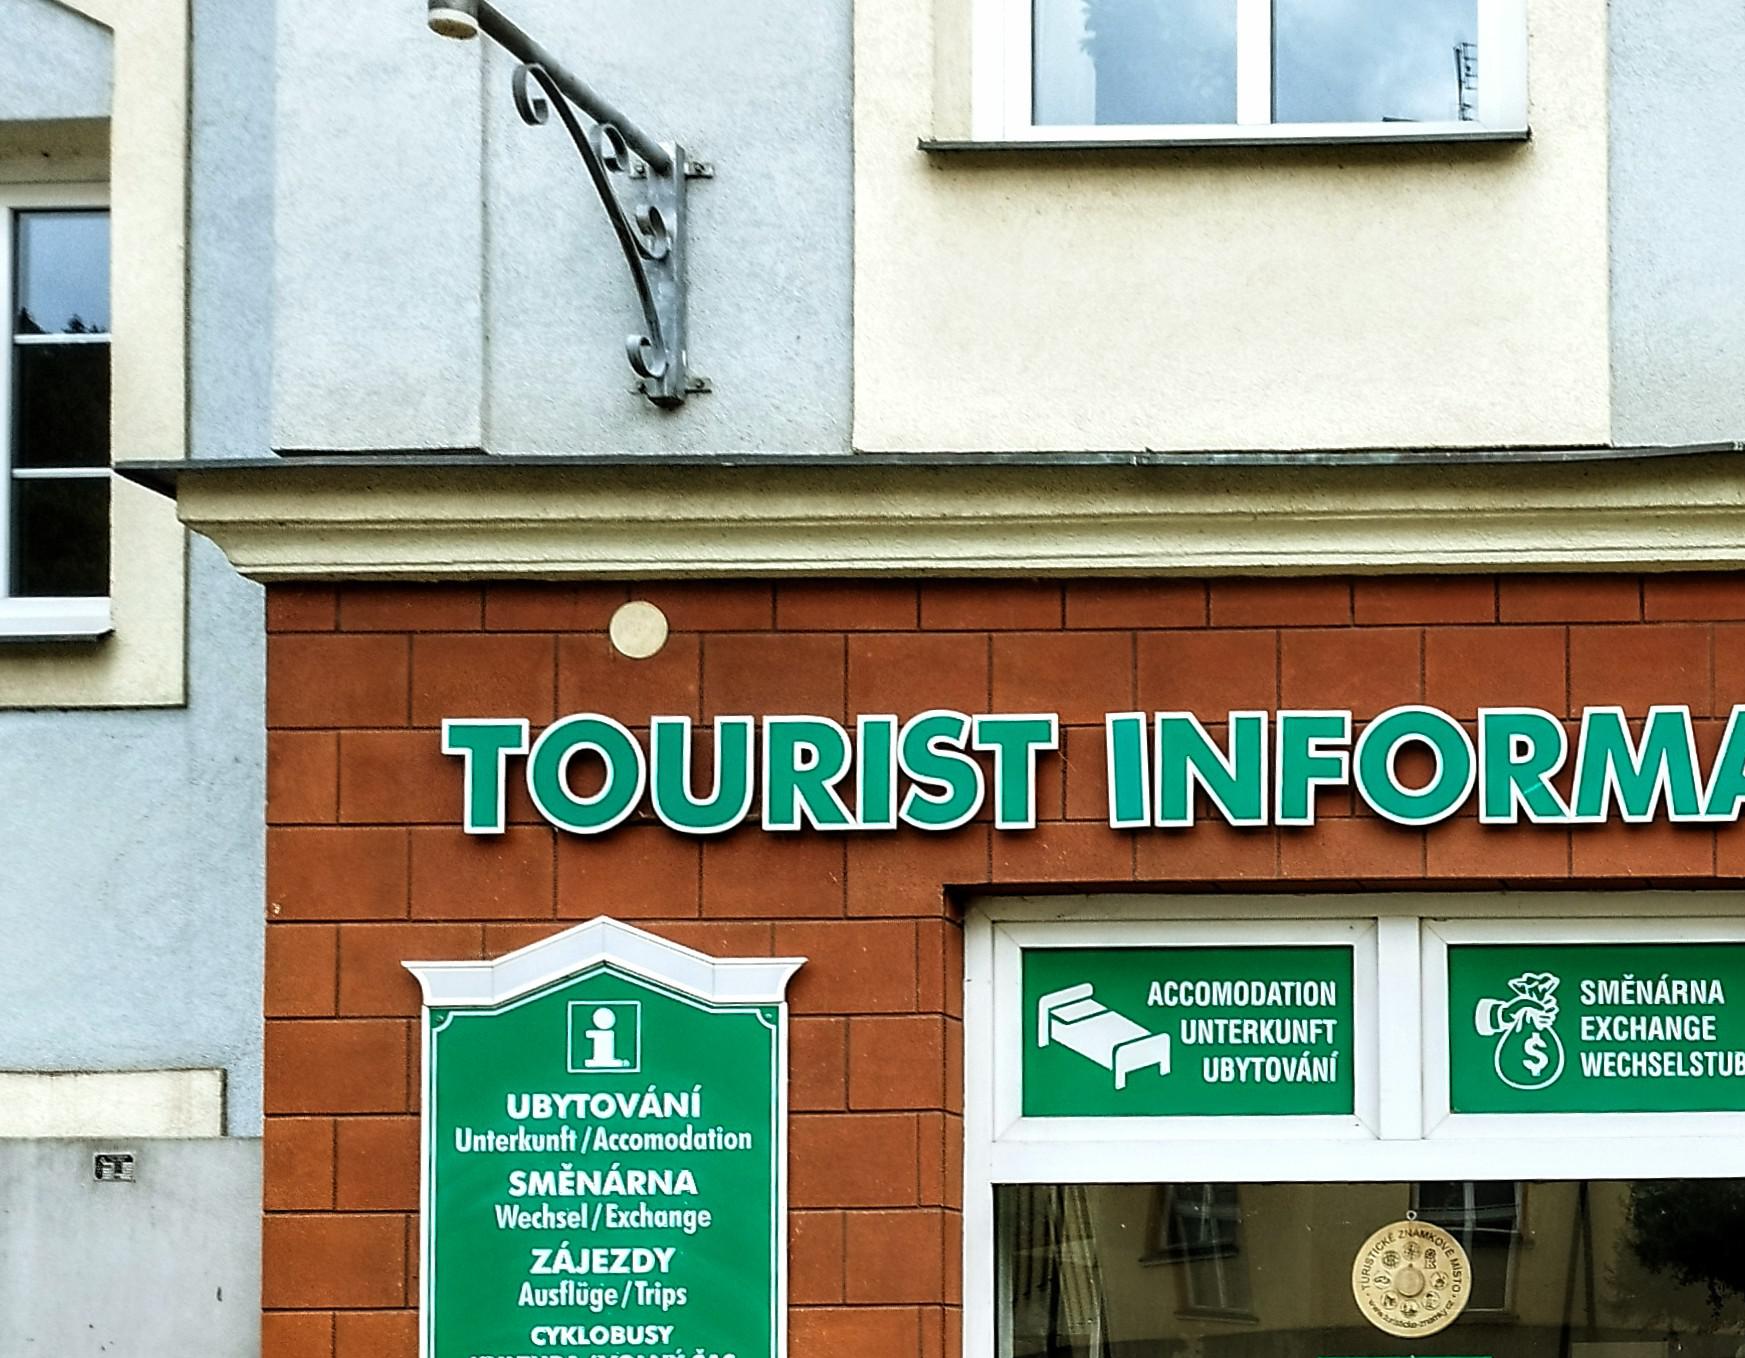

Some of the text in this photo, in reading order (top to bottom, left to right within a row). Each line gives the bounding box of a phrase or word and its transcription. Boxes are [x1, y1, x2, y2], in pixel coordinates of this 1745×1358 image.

[441, 709, 1059, 835] TOURIST
[1147, 980, 1337, 1008] ACCOMODATION
[1580, 973, 1725, 1006] SMĚNÁRNA
[1180, 1018, 1337, 1045] UNTERKUNFT
[1580, 1015, 1717, 1042] EXCHANGE
[1202, 1050, 1339, 1083] UBYTOVÁNÍ
[506, 1084, 703, 1120] UBYTOVÁNÍ
[508, 1163, 699, 1197] SMĚNÁRNA
[529, 1240, 677, 1275] ZÁJEZDY
[530, 1325, 675, 1346] CYKLOBUSY
